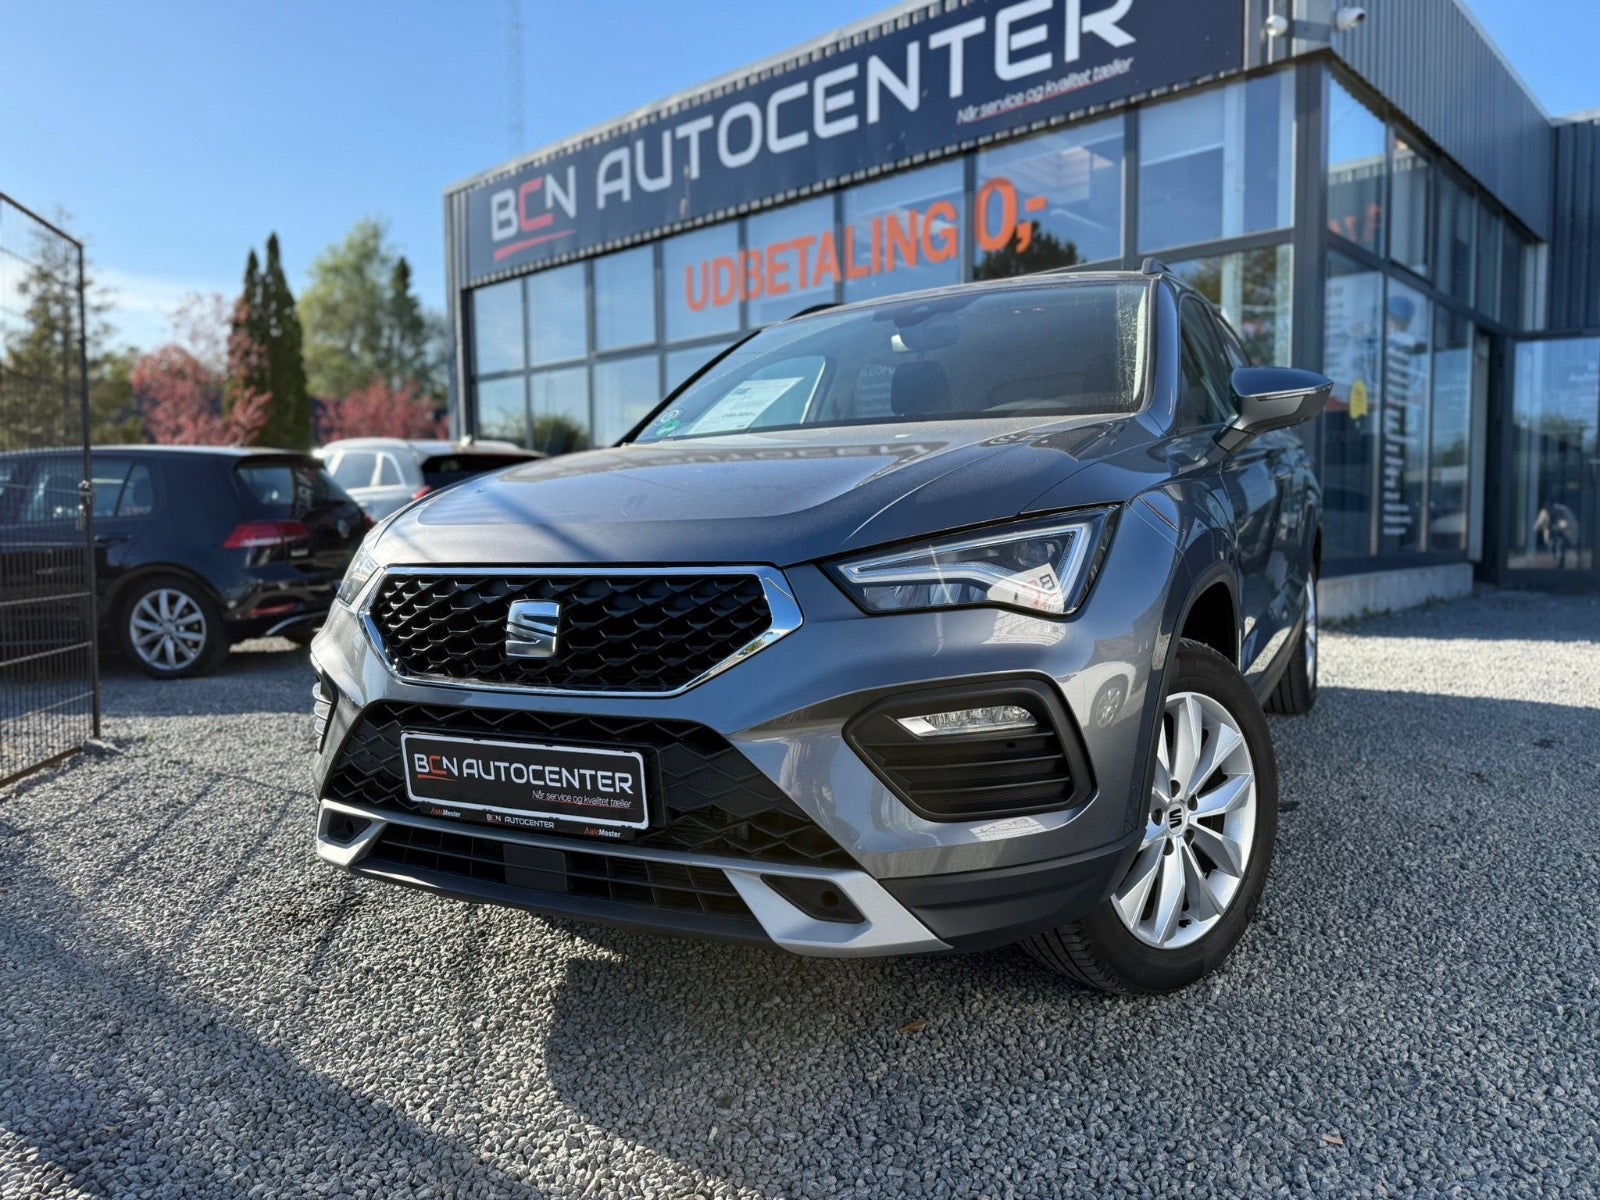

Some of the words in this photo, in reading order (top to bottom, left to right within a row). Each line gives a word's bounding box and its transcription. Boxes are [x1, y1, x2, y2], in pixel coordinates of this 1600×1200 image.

[491, 165, 577, 242] BCN
[596, 0, 1137, 210] AUTOCENTER
[684, 200, 958, 312] UDBETALING
[414, 753, 458, 777] BCN
[462, 758, 635, 795] AUTOCENTER
[532, 789, 545, 800] Når
[546, 793, 572, 802] service
[572, 796, 583, 805] og
[583, 795, 609, 807] kvalitet
[486, 813, 502, 822] BCN
[504, 816, 555, 830] AUTOCENTER
